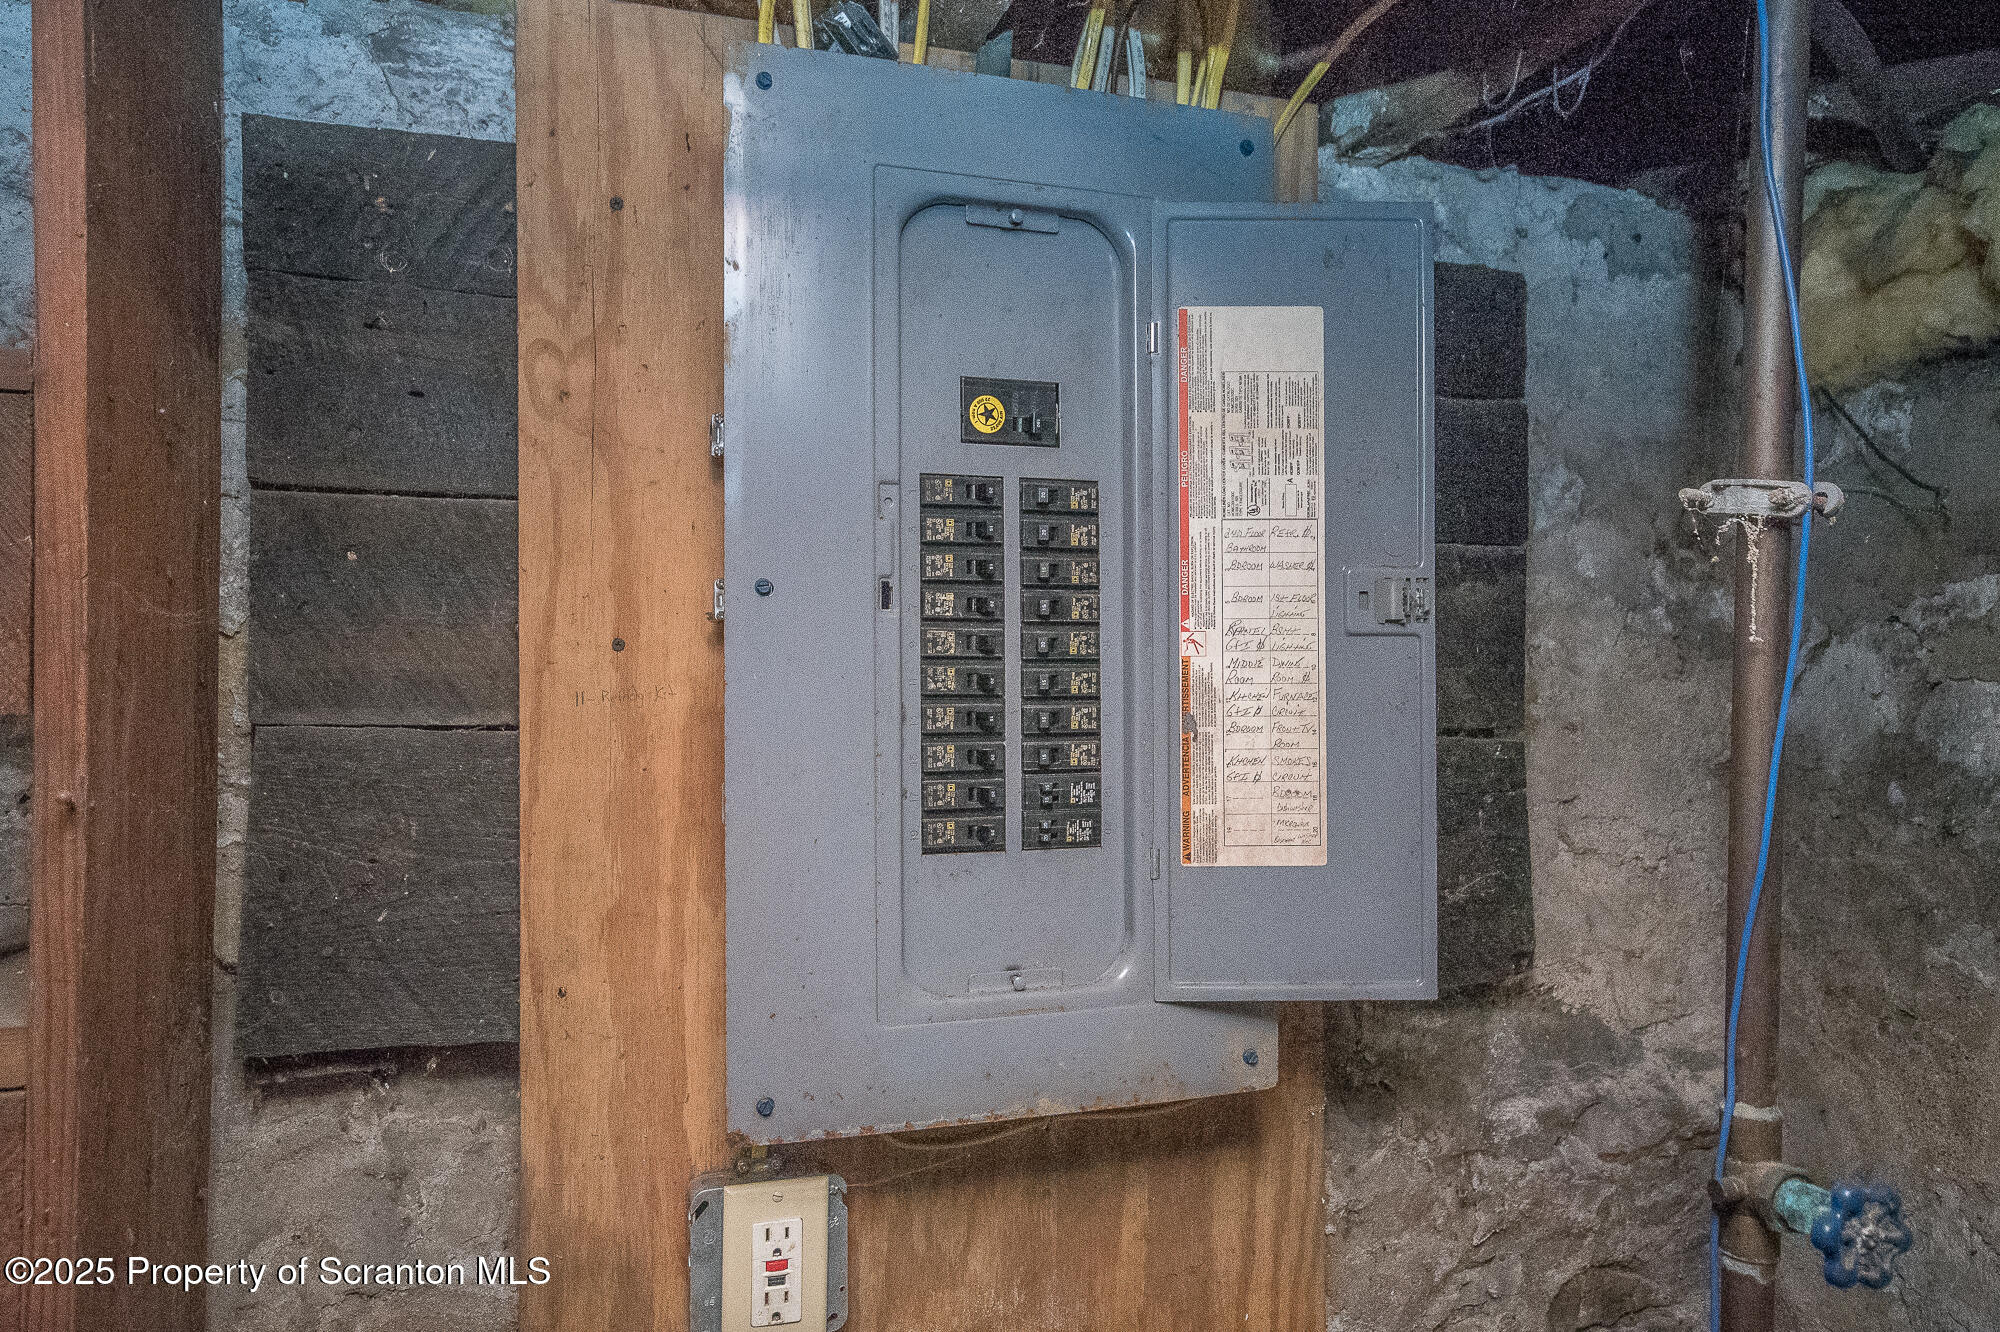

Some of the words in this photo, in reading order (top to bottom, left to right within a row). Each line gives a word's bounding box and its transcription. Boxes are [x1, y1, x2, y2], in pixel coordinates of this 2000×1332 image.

[1226, 670, 1253, 684] ROOM
[1271, 672, 1294, 682] ROOM
[1273, 738, 1299, 748] ROOM
